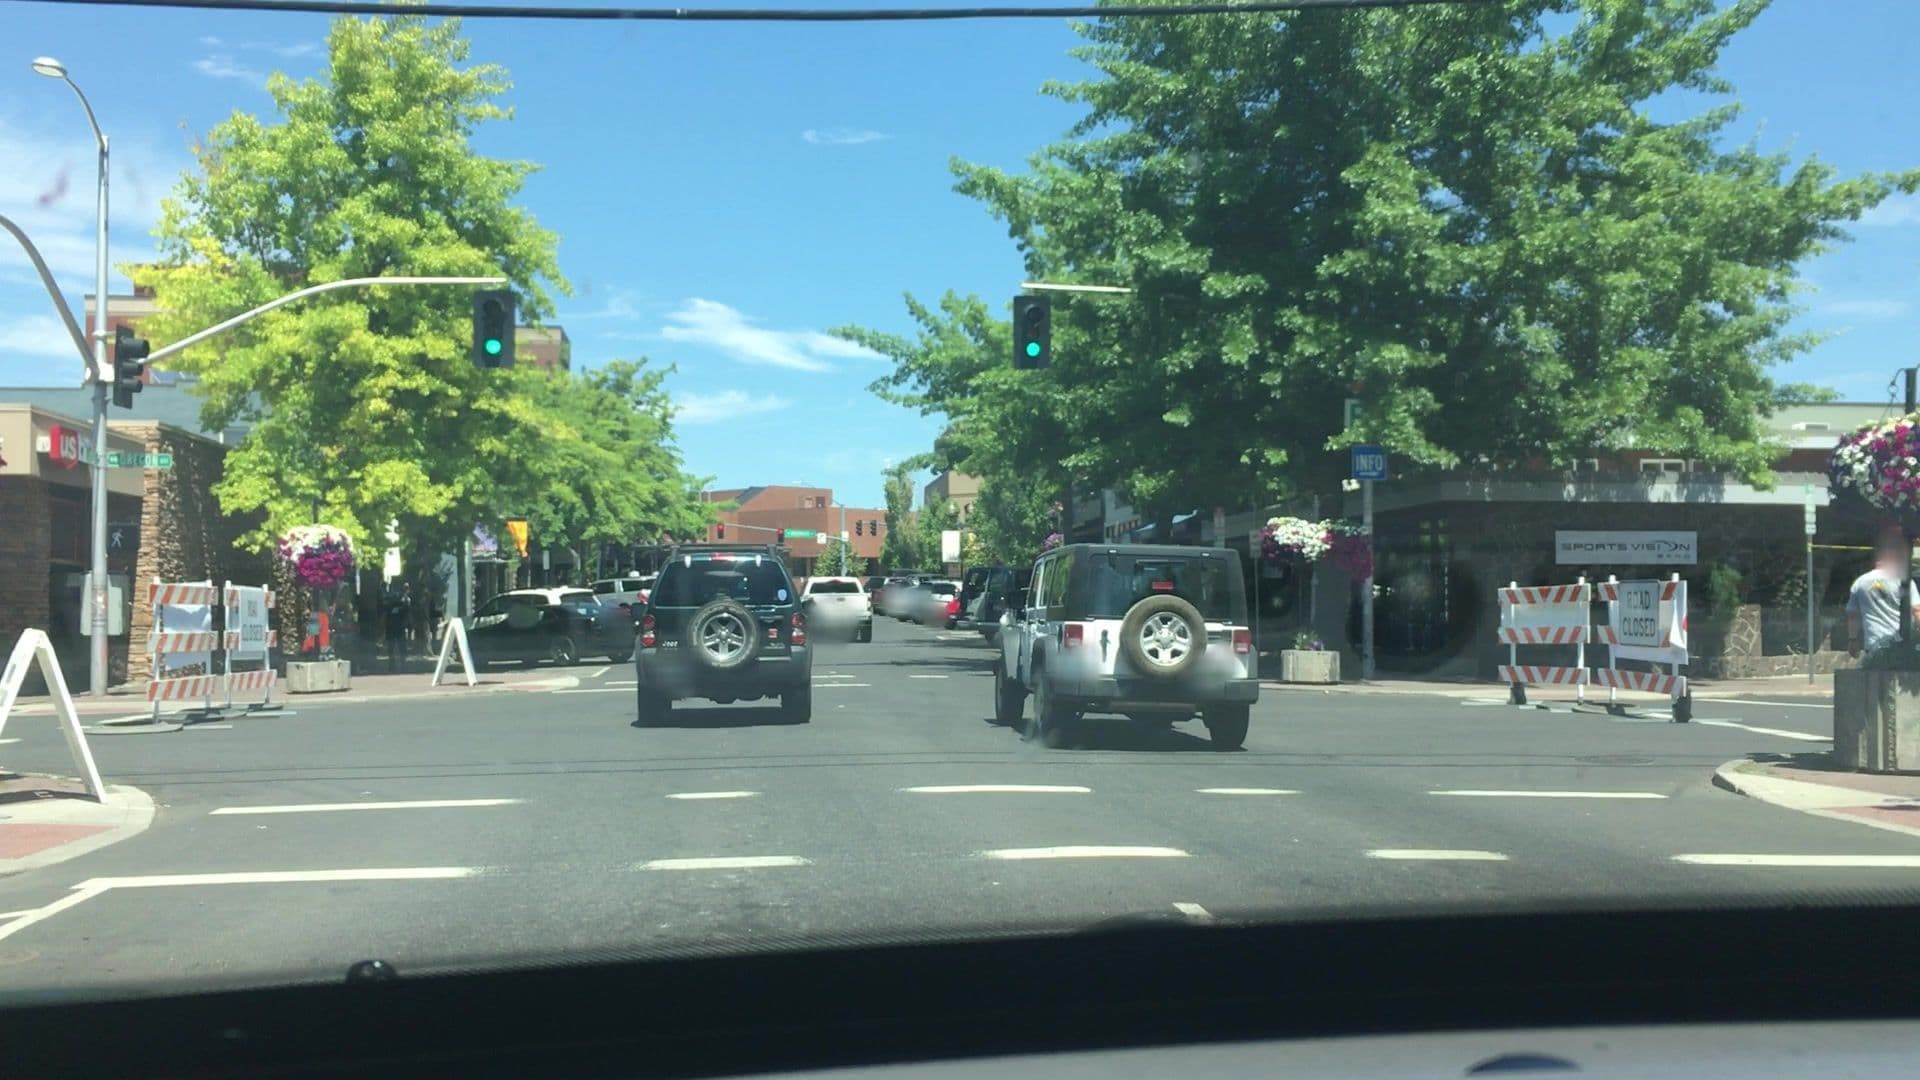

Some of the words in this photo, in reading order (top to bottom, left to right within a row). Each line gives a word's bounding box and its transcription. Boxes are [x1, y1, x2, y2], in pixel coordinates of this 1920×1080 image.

[1356, 454, 1383, 472] INFO
[1561, 543, 1628, 551] SPORTS
[1631, 540, 1690, 551] VISION
[1627, 591, 1650, 609] ROAD
[1623, 617, 1655, 636] CLOSED
